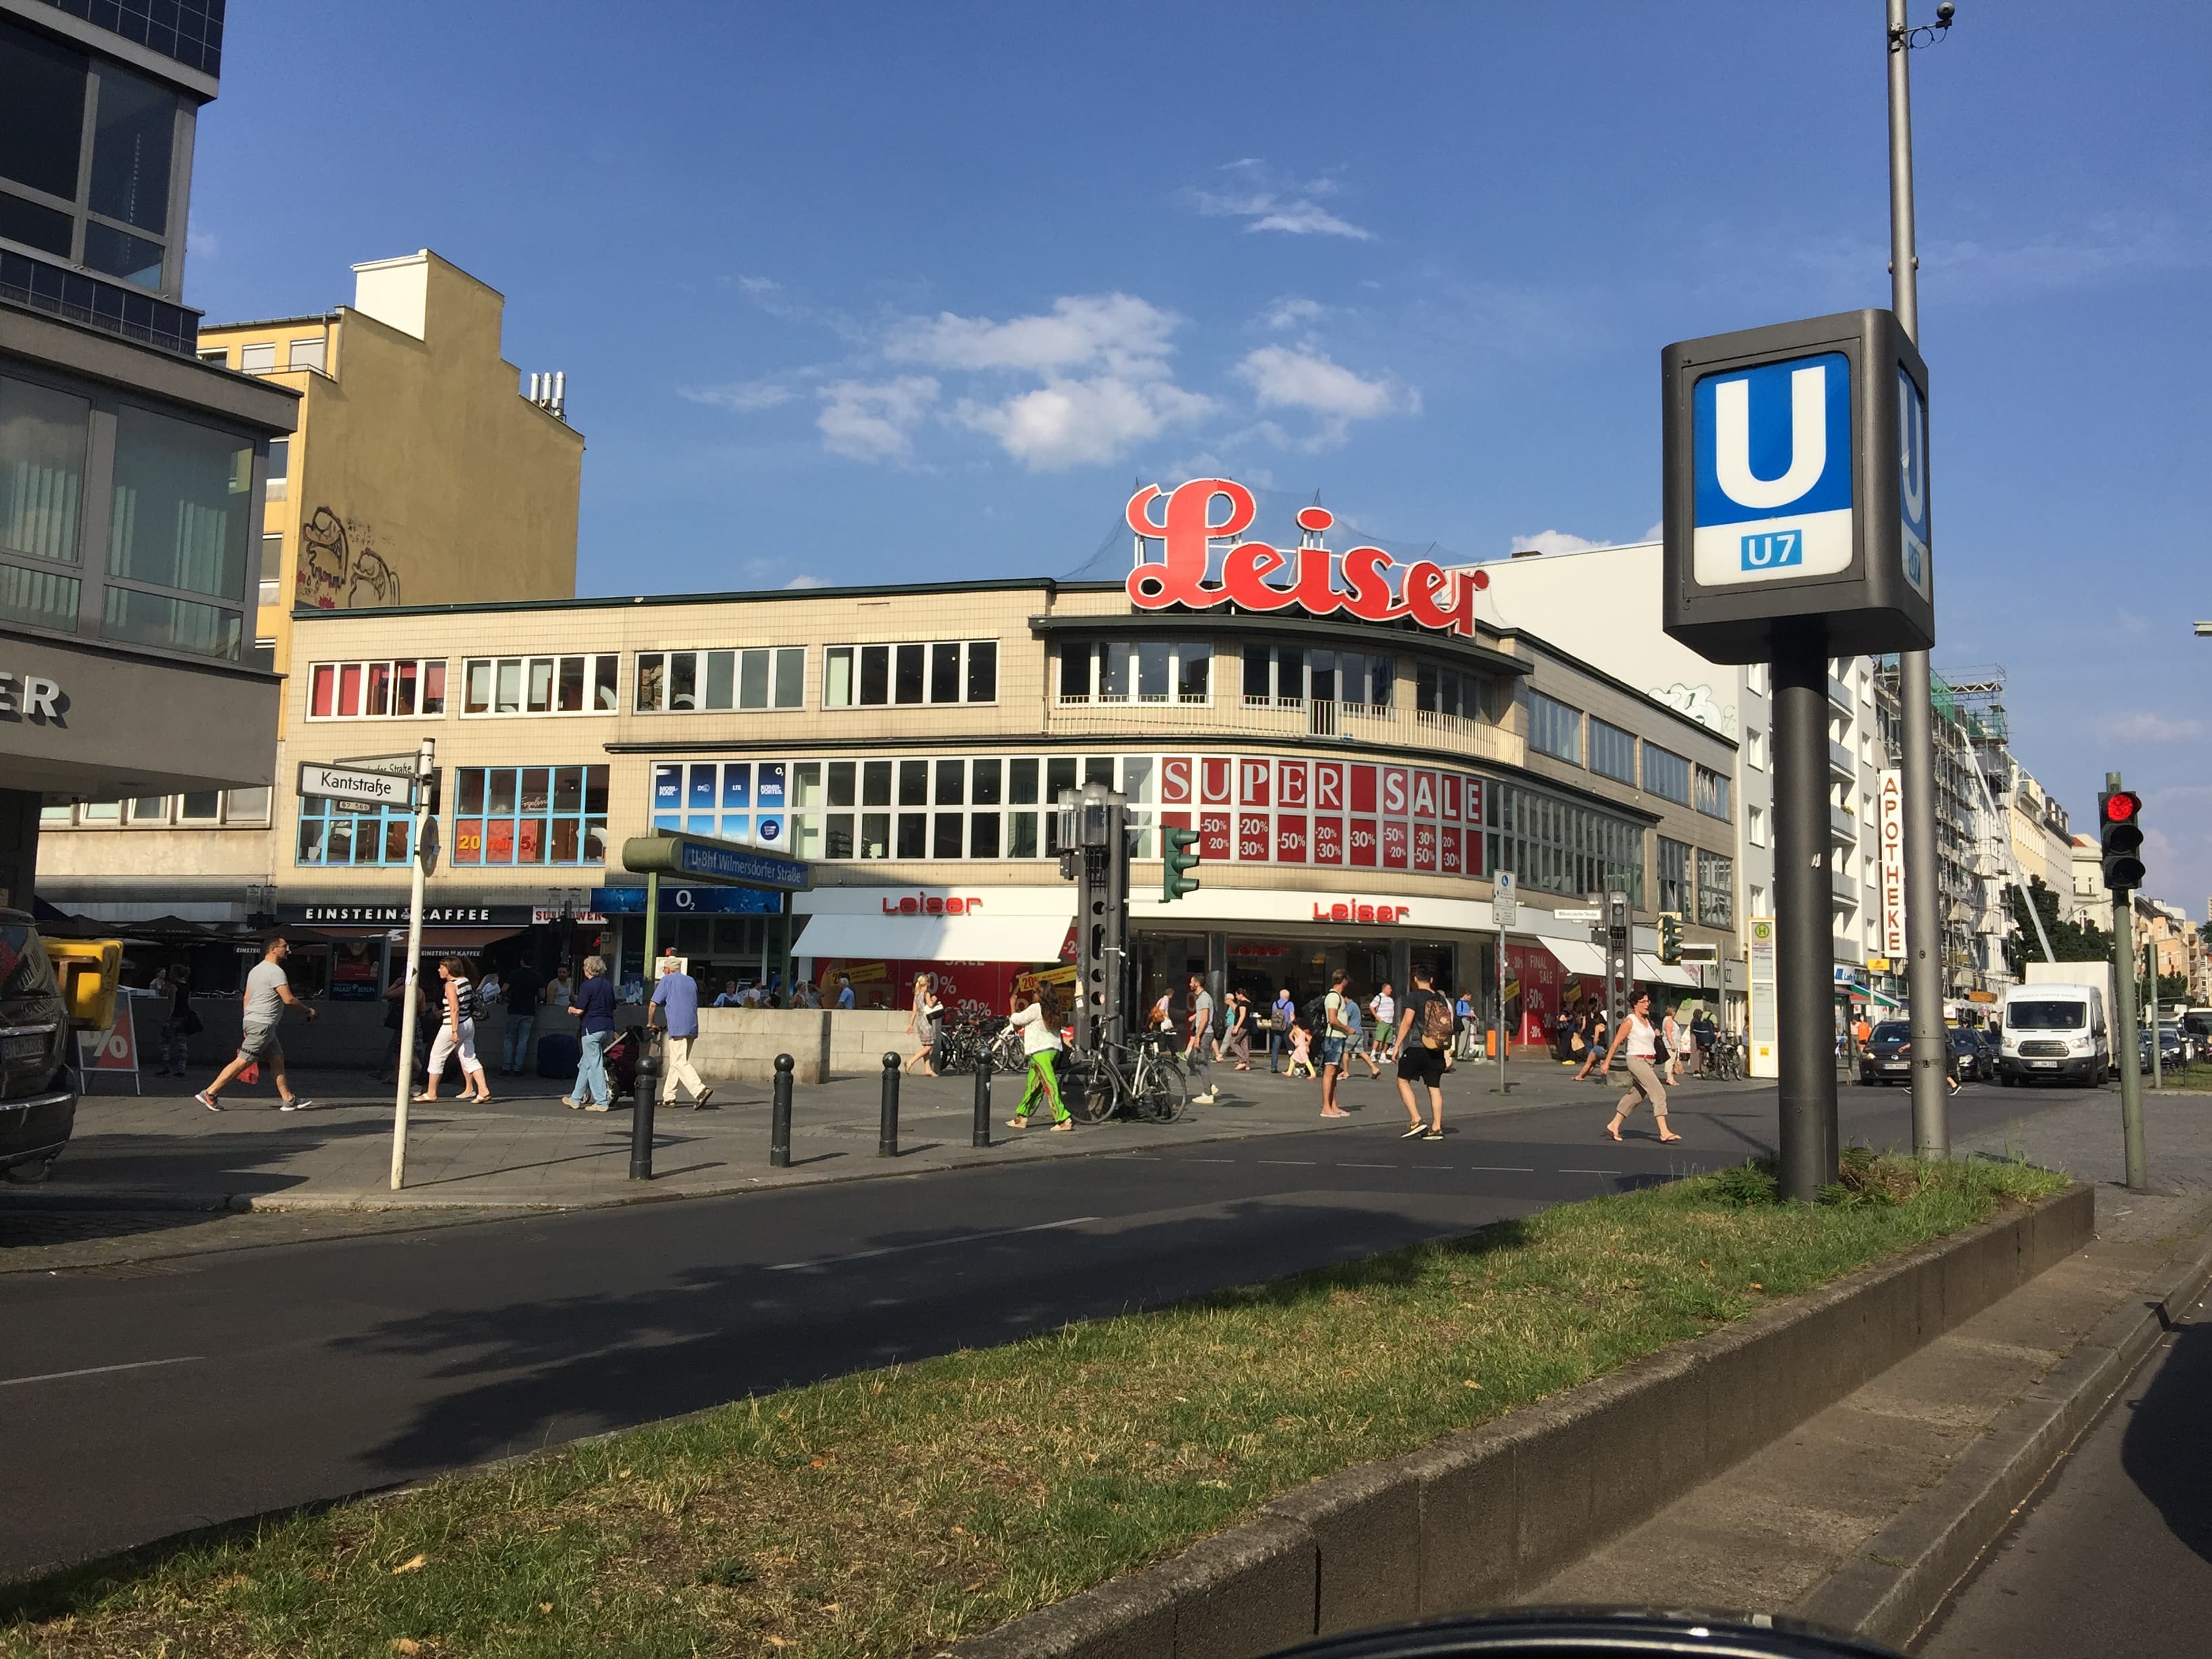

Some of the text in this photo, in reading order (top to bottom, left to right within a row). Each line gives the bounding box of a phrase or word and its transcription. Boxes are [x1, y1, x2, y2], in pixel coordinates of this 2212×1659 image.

[1716, 366, 1826, 508] U
[1898, 375, 1924, 525] U
[1126, 478, 1490, 638] Leiser
[1748, 534, 1795, 566] U7
[321, 771, 392, 796] Kantstraße
[1163, 762, 1479, 820] SUPER SALE
[458, 836, 480, 850] 20
[718, 854, 775, 878] Wilmersdorfer
[777, 865, 801, 883] Straße
[1883, 777, 1900, 951] APOTHEKE
[306, 908, 396, 920] EINSTEIN
[882, 891, 983, 914] Leiser
[1313, 898, 1410, 922] Leiser
[1063, 940, 1078, 954] -2
[1530, 955, 1547, 969] FINAL
[1539, 970, 1553, 984] SALE
[1527, 989, 1544, 1009] -50%
